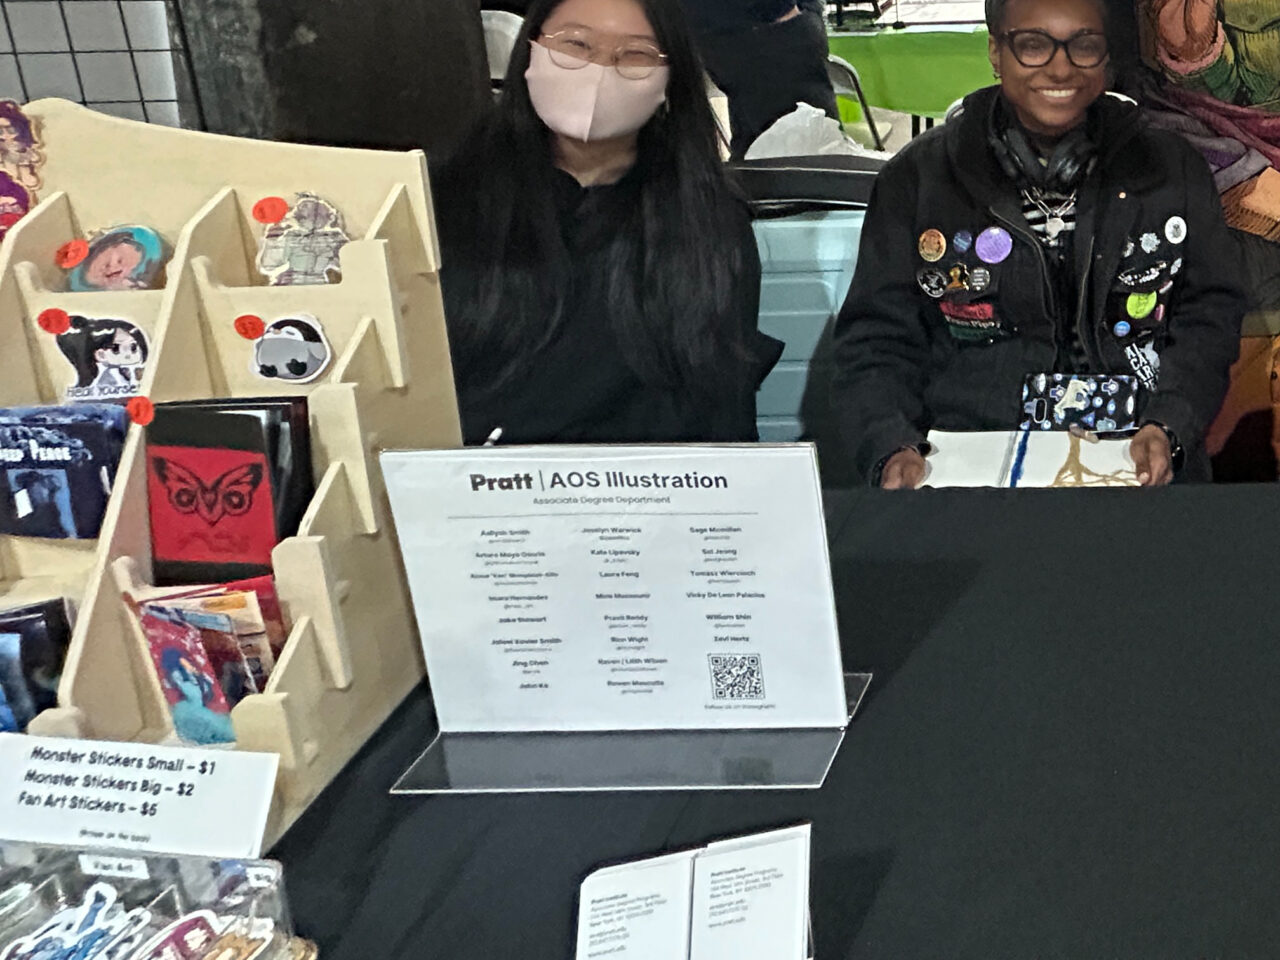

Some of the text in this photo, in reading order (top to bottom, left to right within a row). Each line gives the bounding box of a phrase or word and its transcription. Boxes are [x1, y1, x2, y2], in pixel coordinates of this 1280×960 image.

[470, 471, 728, 491] Pratt AOS Illustration
[533, 496, 671, 505] Associate Degree Department
[31, 745, 86, 762] Monster
[88, 750, 144, 769] Stickers
[147, 756, 184, 772] Small
[199, 760, 217, 775] $1
[24, 769, 79, 788] Monster
[82, 774, 137, 792] Stickers
[140, 779, 162, 796] Big
[177, 783, 195, 797] $2
[18, 791, 42, 807] Fan
[43, 794, 67, 809] Art
[68, 795, 126, 813] Stickers
